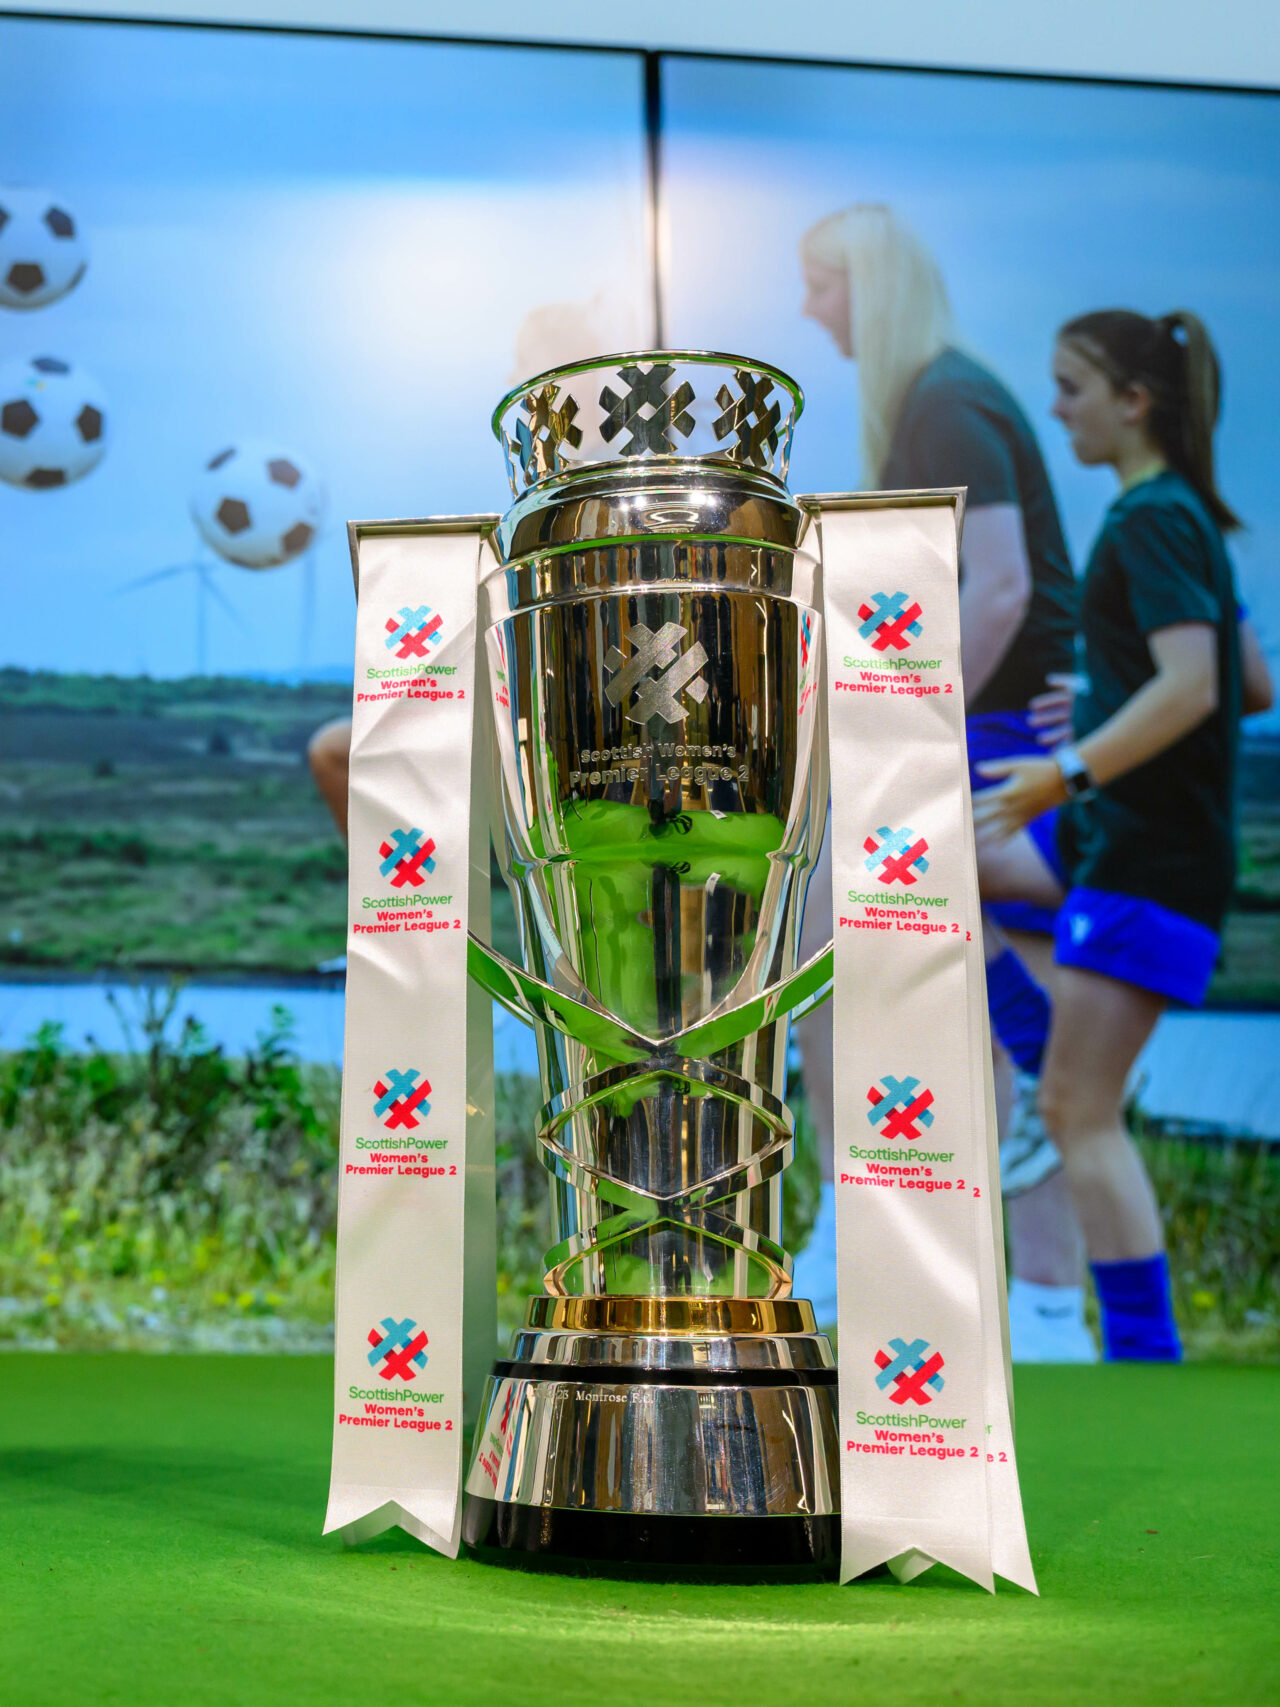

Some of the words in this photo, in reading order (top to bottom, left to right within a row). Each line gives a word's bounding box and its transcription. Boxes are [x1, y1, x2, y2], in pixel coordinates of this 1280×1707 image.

[843, 656, 942, 670] ScottishPower
[367, 664, 457, 679] ScottishPower
[860, 672, 921, 683] Women's
[381, 678, 437, 689] Women's
[835, 681, 886, 693] Premier
[890, 685, 940, 698] League
[944, 684, 952, 693] 2
[357, 690, 404, 702] Premier
[408, 689, 453, 701] League
[457, 690, 465, 699] 2
[658, 742, 737, 758] Women's
[569, 764, 648, 787] Premier
[655, 763, 733, 785] League
[737, 764, 749, 782] 2
[362, 894, 452, 909] ScottishPower
[848, 890, 949, 906] ScottishPower
[377, 909, 433, 921] Women's
[865, 907, 928, 920] Women's
[354, 922, 400, 934] Premier
[404, 921, 449, 933] League
[453, 919, 461, 929] 2
[840, 917, 892, 930] Premier
[896, 921, 947, 934] League
[951, 924, 959, 933] 2
[356, 1137, 448, 1149] ScottishPower
[370, 1153, 428, 1163] Women's
[849, 1146, 954, 1162] ScottishPower
[346, 1164, 393, 1174] Premier
[398, 1165, 445, 1178] League
[449, 1165, 456, 1175] 2
[866, 1163, 932, 1176] Women's
[840, 1174, 894, 1187] Premier
[899, 1178, 952, 1192] League
[957, 1180, 965, 1189] 2
[973, 1188, 980, 1197] 2
[349, 1386, 444, 1403] ScottishPower
[576, 1391, 627, 1403] Montrose
[365, 1404, 424, 1417] Women's
[339, 1414, 390, 1427] Premier
[394, 1418, 441, 1432] League
[445, 1420, 453, 1430] 2
[856, 1411, 966, 1428] ScottishPower
[875, 1430, 944, 1443] Women's
[847, 1441, 904, 1455] Premier
[910, 1445, 965, 1460] League
[970, 1447, 979, 1457] 2
[999, 1452, 1007, 1462] 2
